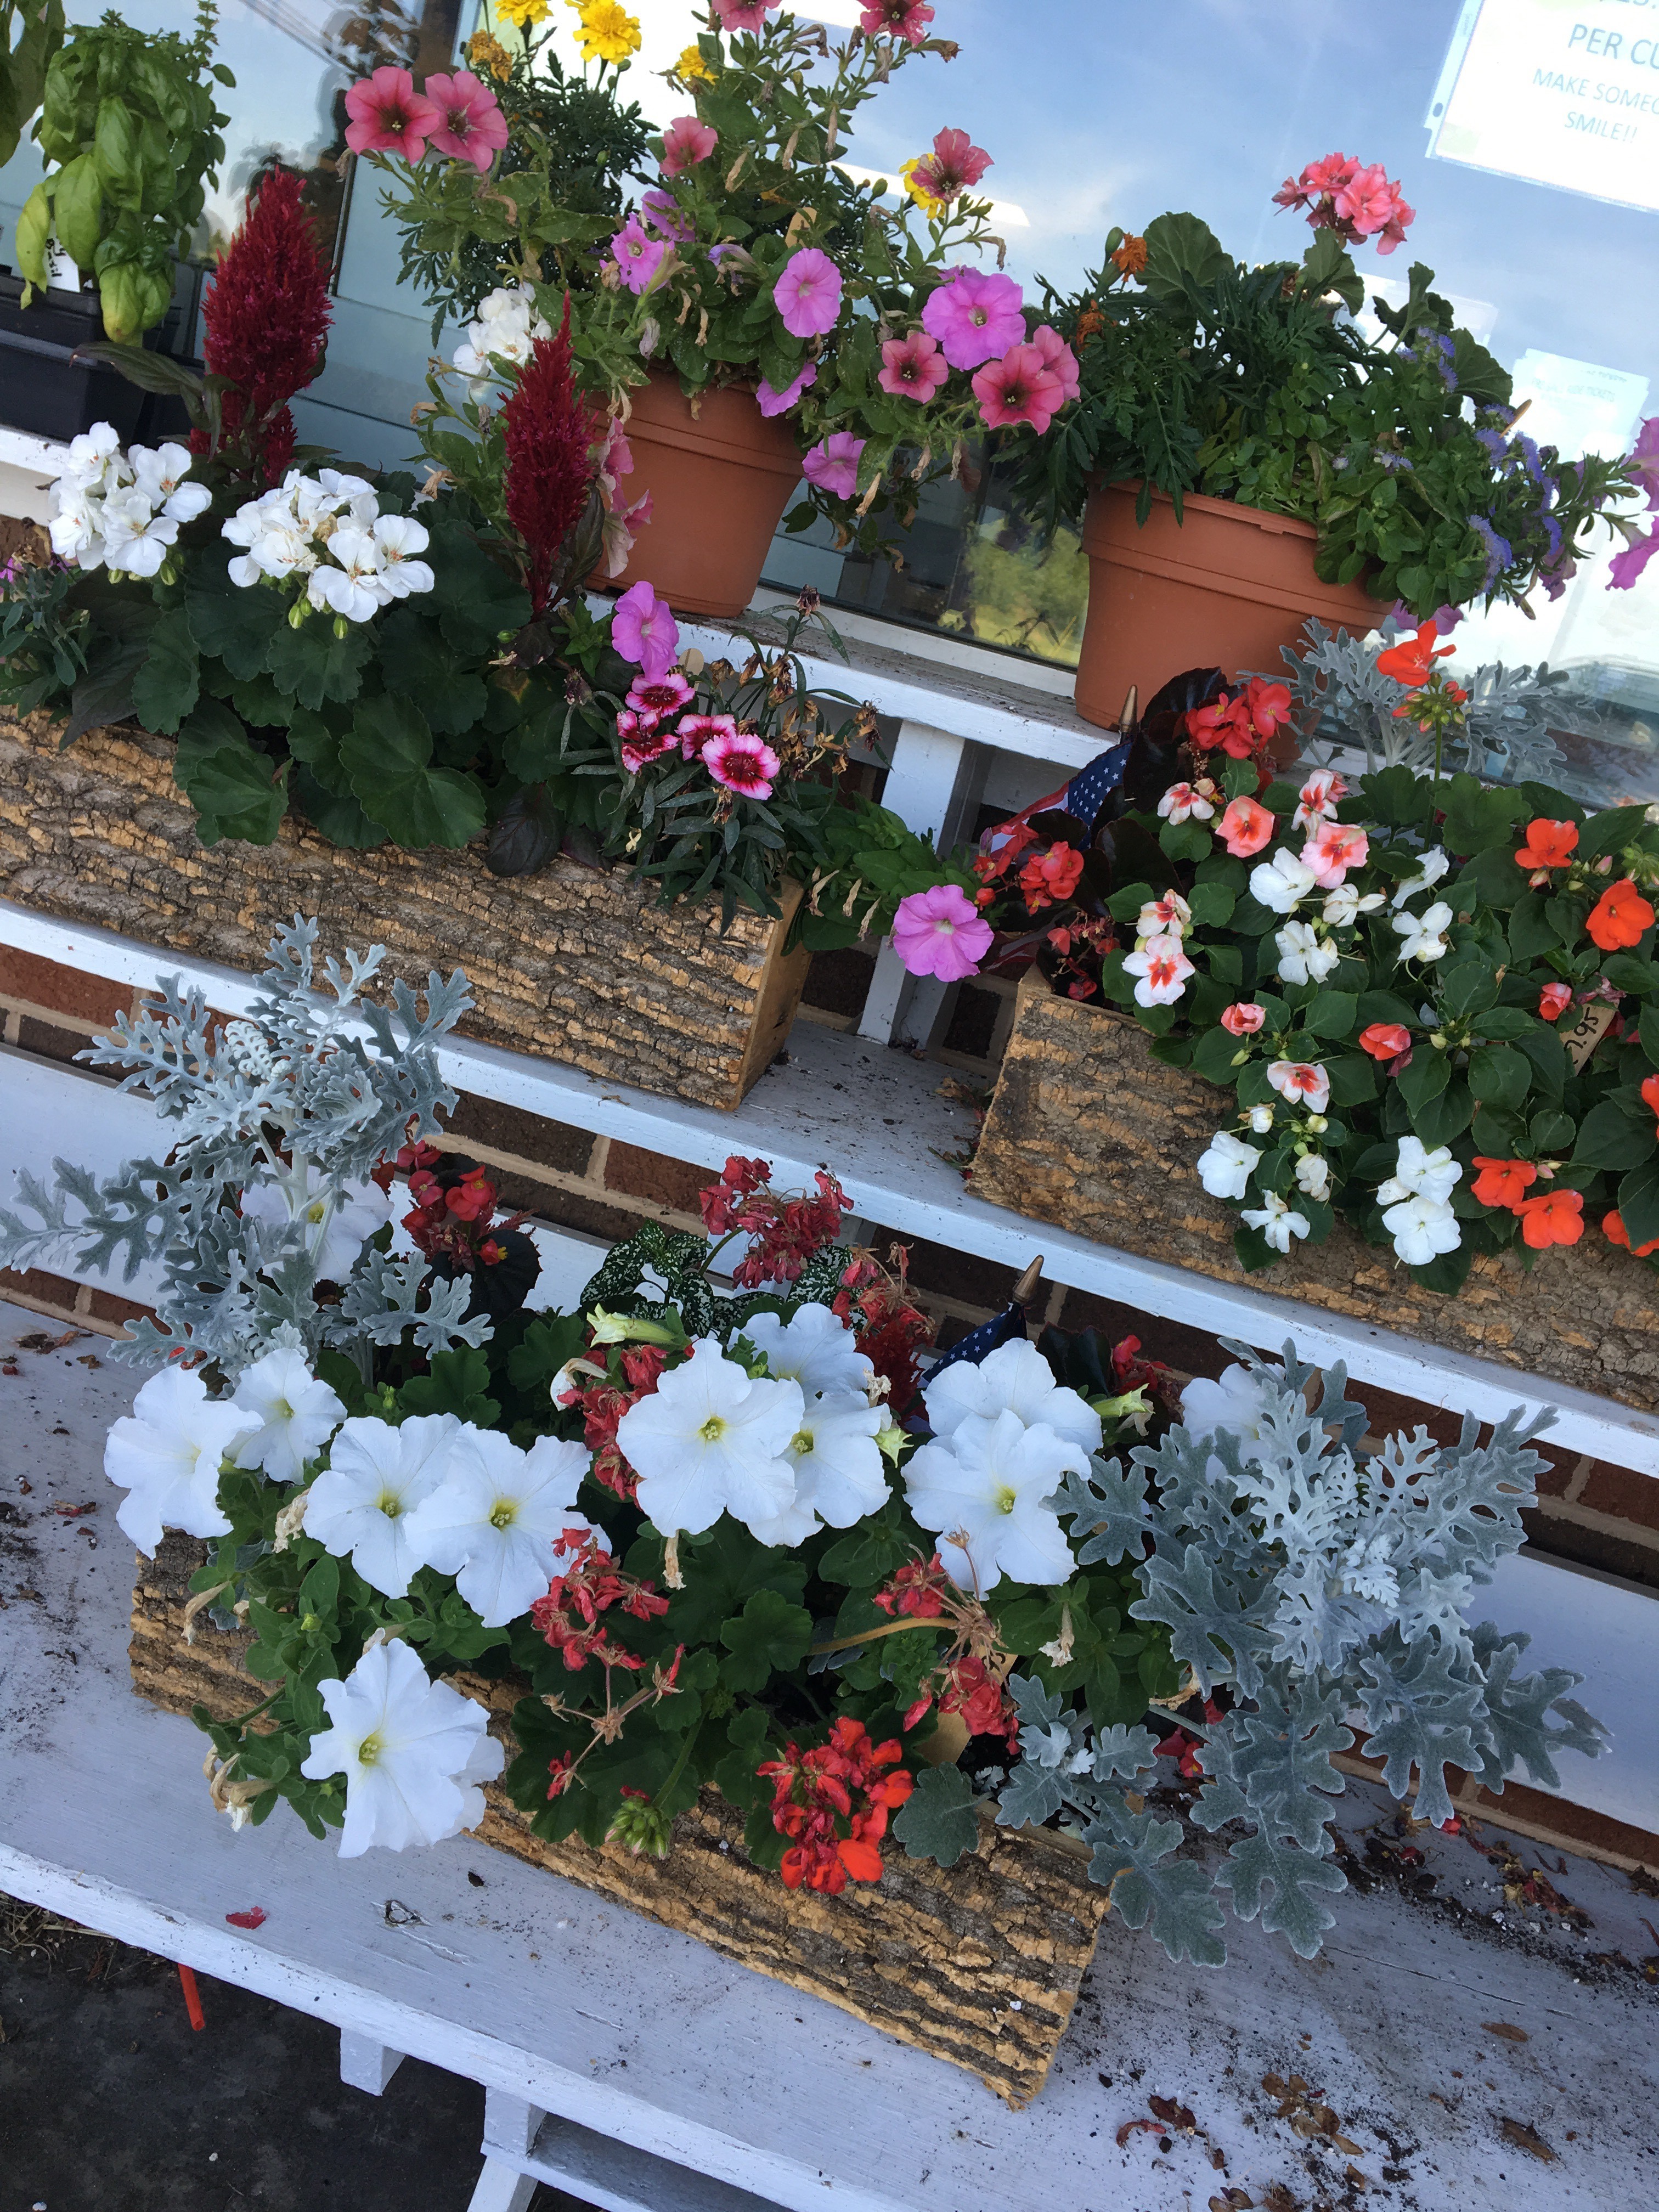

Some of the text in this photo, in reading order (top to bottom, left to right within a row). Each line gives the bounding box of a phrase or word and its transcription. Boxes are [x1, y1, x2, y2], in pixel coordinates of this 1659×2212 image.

[1568, 24, 1622, 59] PER
[1533, 68, 1590, 97] MAKE
[1564, 111, 1638, 144] SMILE!!
[1564, 1007, 1599, 1065] 7.95
